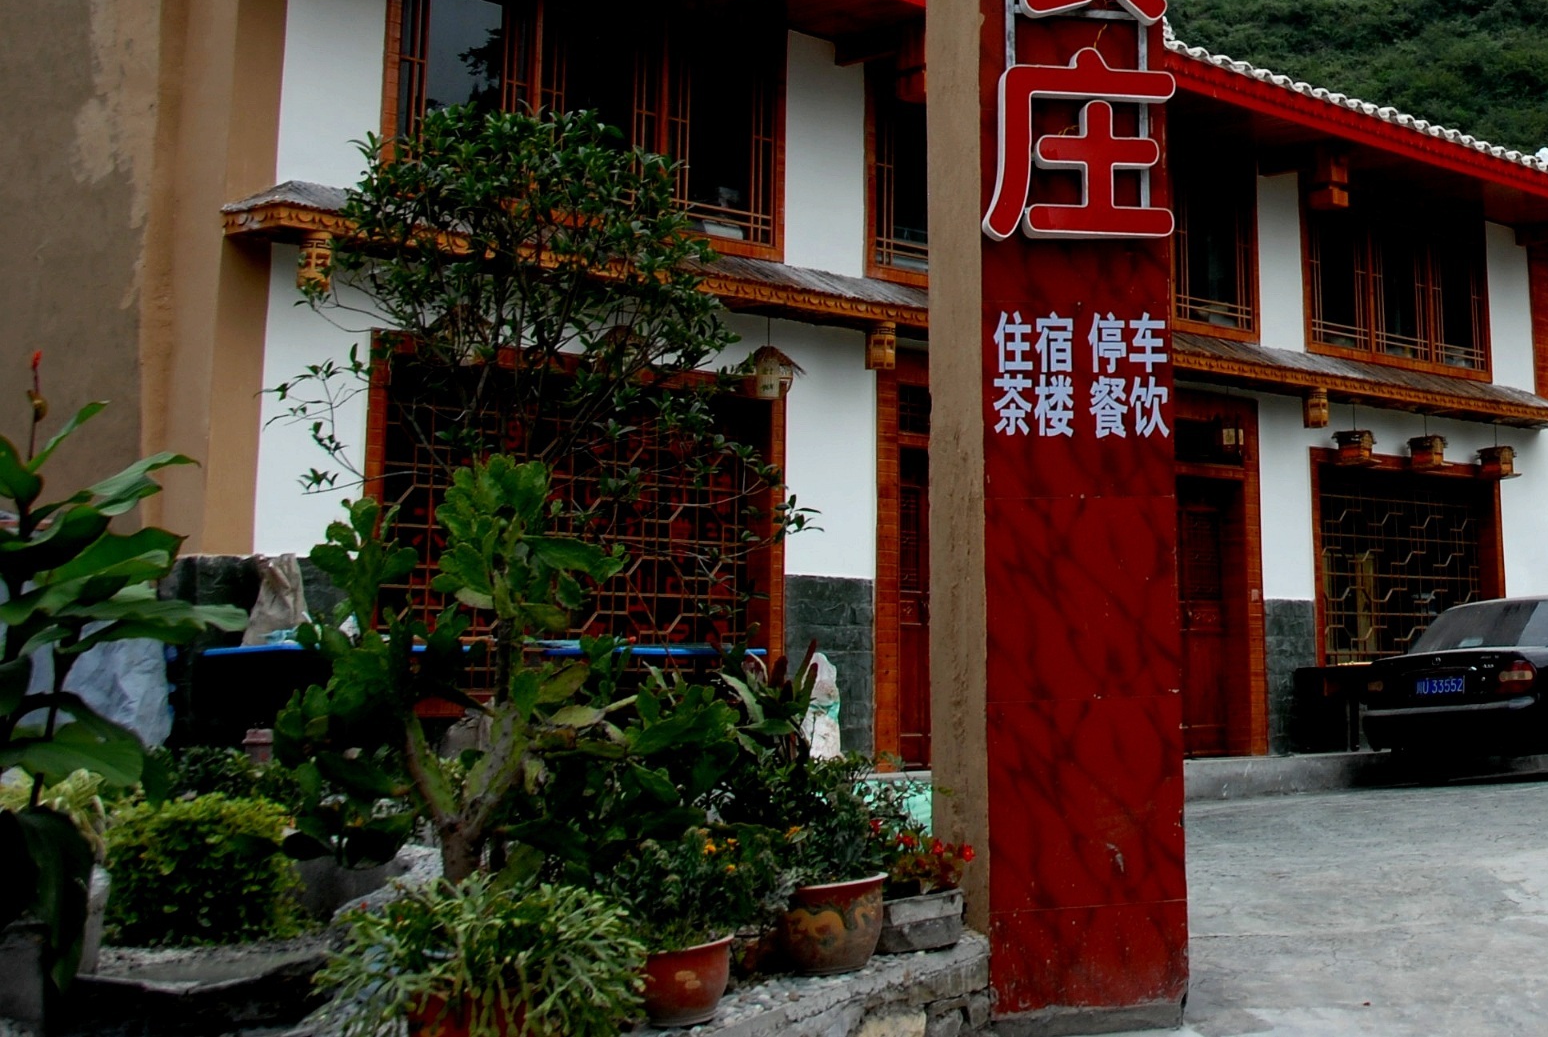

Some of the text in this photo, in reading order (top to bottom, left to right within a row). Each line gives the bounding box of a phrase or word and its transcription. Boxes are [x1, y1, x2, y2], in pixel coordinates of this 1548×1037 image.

[993, 310, 1168, 373] 住宿 停车
[993, 373, 1170, 438] 茶楼 餐饮
